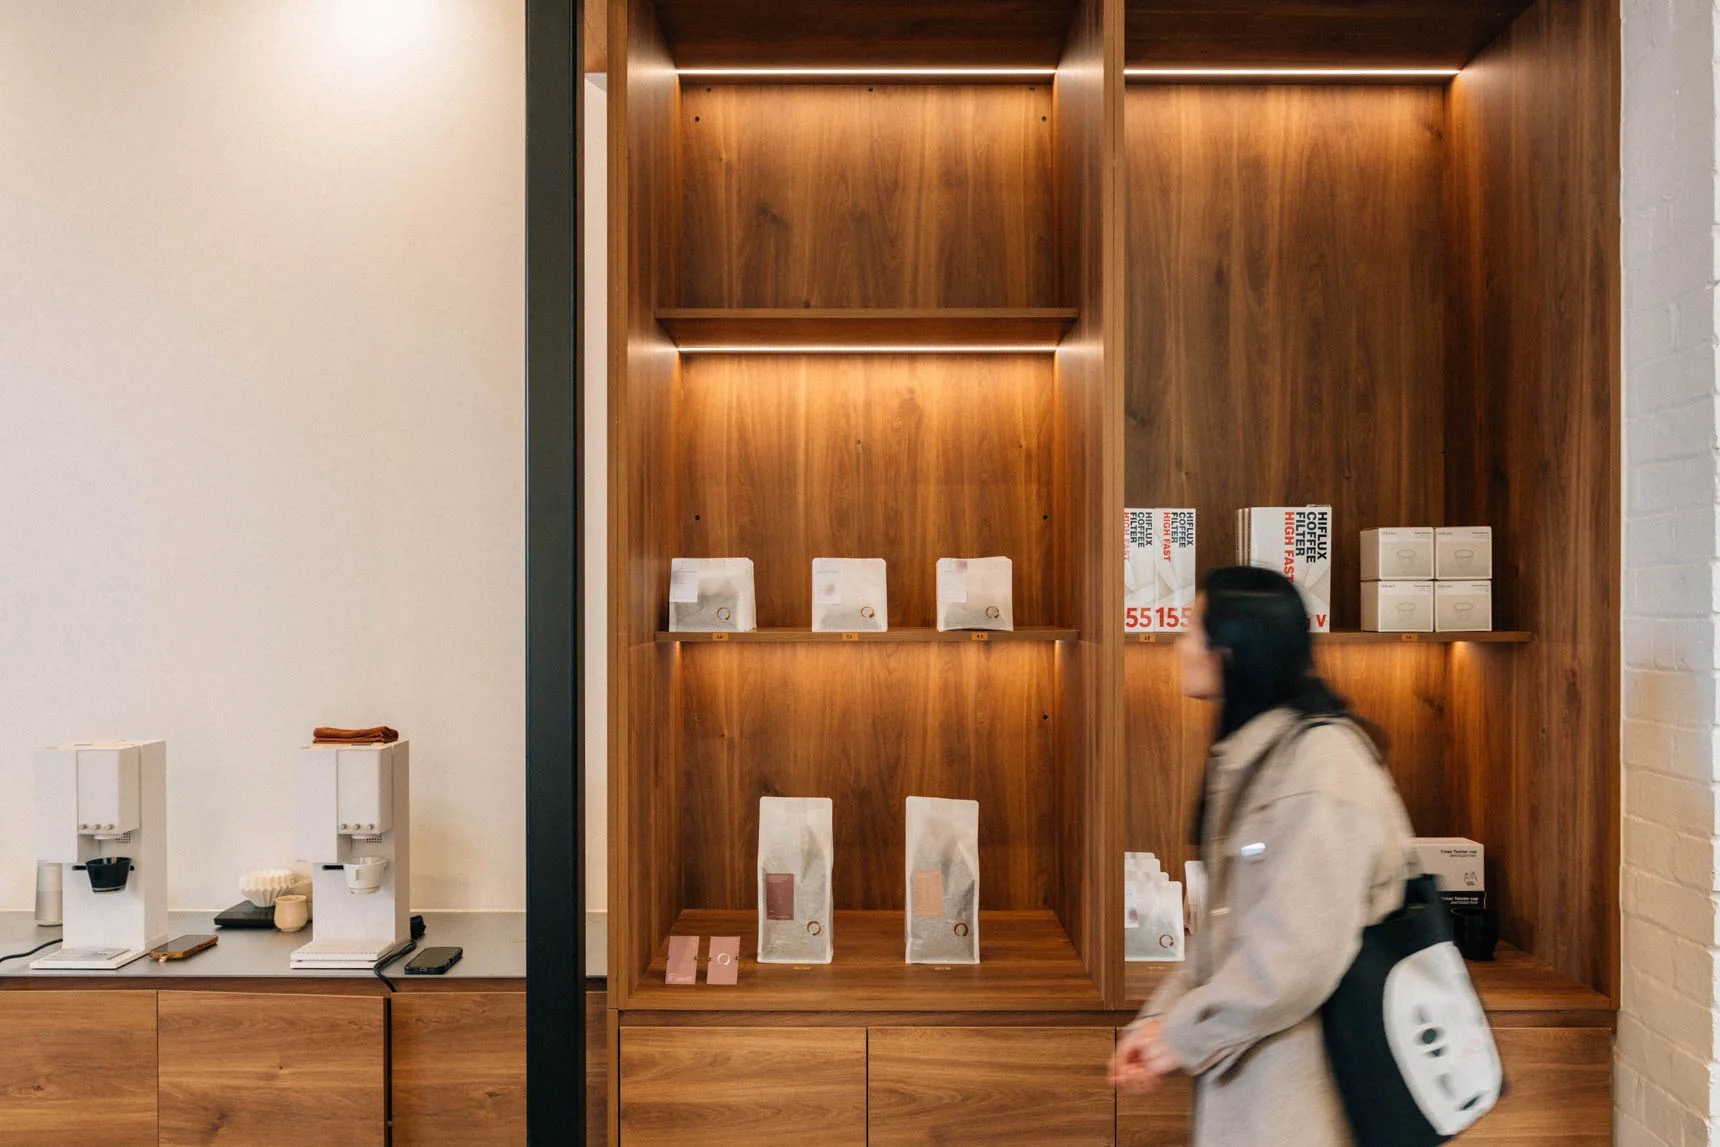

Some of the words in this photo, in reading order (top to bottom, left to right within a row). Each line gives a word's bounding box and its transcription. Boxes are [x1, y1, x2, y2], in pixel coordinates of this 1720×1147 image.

[1137, 512, 1145, 548] COFFEE
[1171, 512, 1179, 544] FILTER
[1178, 512, 1186, 548] COFFEE
[1186, 512, 1194, 546] HIFLUX
[1284, 511, 1295, 546] HIGH
[1295, 511, 1306, 556] FILTER
[1306, 511, 1317, 564] COFFEE
[1317, 511, 1328, 560] HIFLUX
[1163, 538, 1171, 562] FAST
